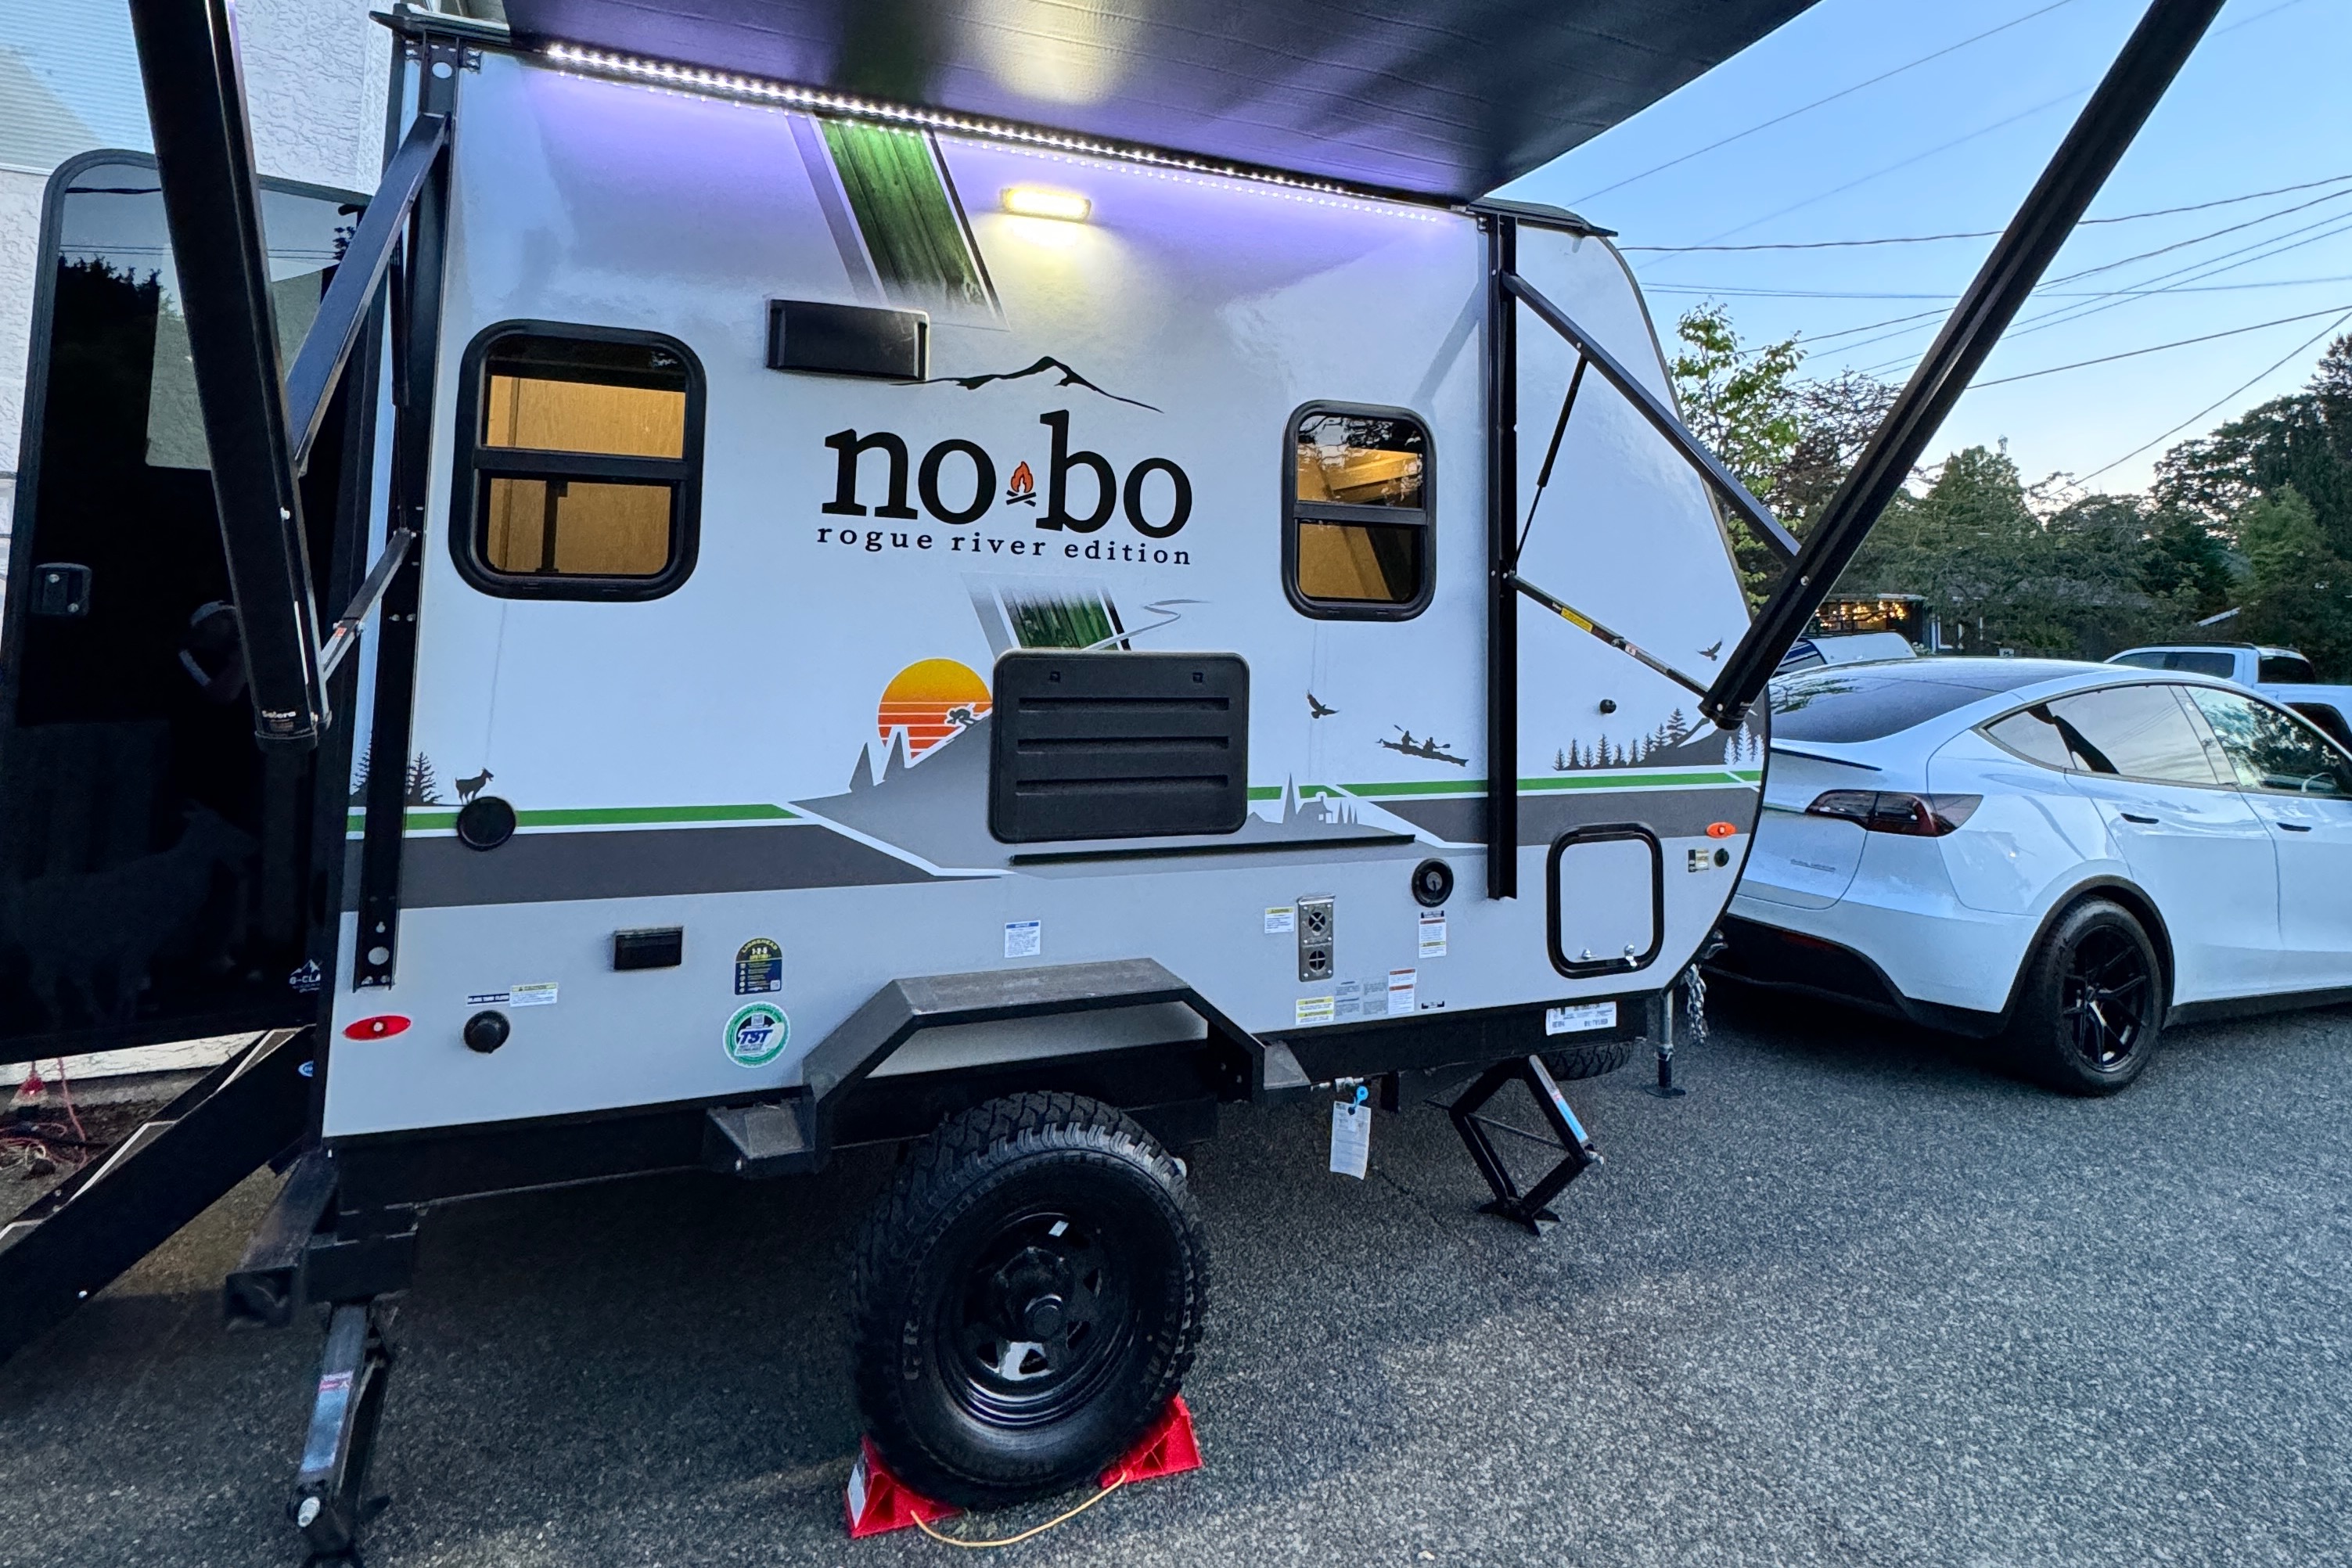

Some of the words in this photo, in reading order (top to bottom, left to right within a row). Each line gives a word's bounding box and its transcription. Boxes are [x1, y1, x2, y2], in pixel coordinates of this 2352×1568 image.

[817, 527, 933, 552] rogue
[951, 532, 1047, 557] river
[1064, 539, 1191, 565] edition
[740, 1029, 773, 1045] TST
